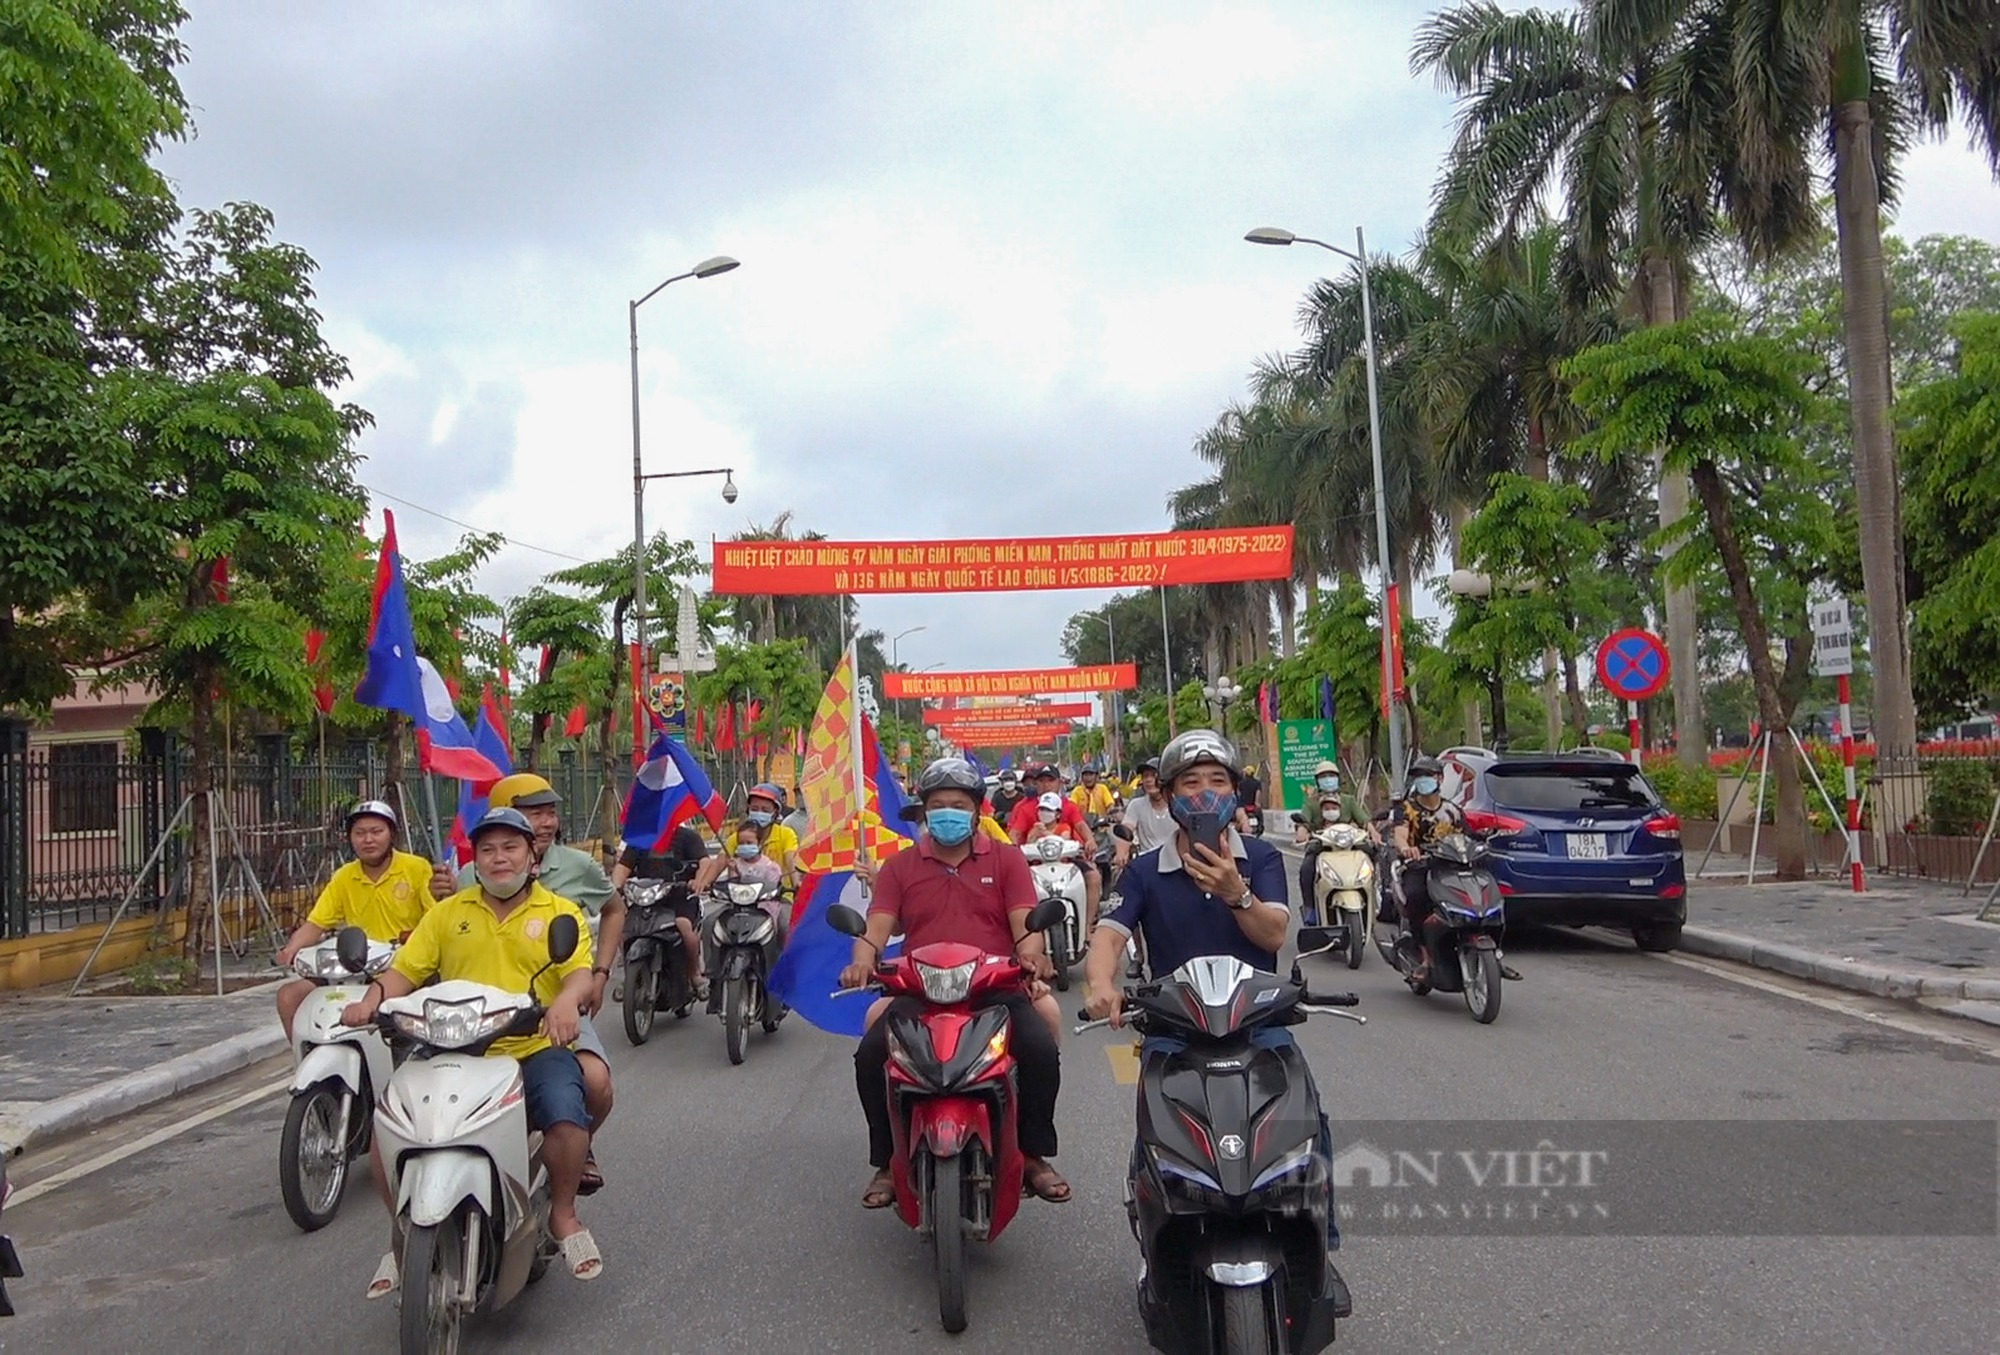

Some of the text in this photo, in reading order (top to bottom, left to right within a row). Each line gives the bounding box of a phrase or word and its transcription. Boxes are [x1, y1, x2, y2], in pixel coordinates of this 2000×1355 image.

[725, 547, 757, 569] NHIỆT
[760, 547, 782, 569] LIỆT
[785, 546, 813, 566] CHÀO
[852, 548, 867, 566] 47
[897, 545, 925, 565] NGÀY
[954, 543, 991, 563] PHÓNG
[1099, 538, 1129, 560] NHẤT
[1131, 537, 1152, 559] ĐẤT
[834, 569, 849, 589] VÀ
[853, 571, 874, 588] 136
[911, 567, 941, 587] NGÀY
[944, 565, 976, 589] QUỐC
[980, 565, 997, 587] TẾ
[998, 568, 1020, 586] LAO
[1025, 566, 1056, 588] ĐỘNG
[1032, 673, 1049, 692] VIỆT
[1050, 674, 1068, 689] NAM
[1578, 834, 1597, 846] 18A
[1206, 1060, 1242, 1068] HONDA
